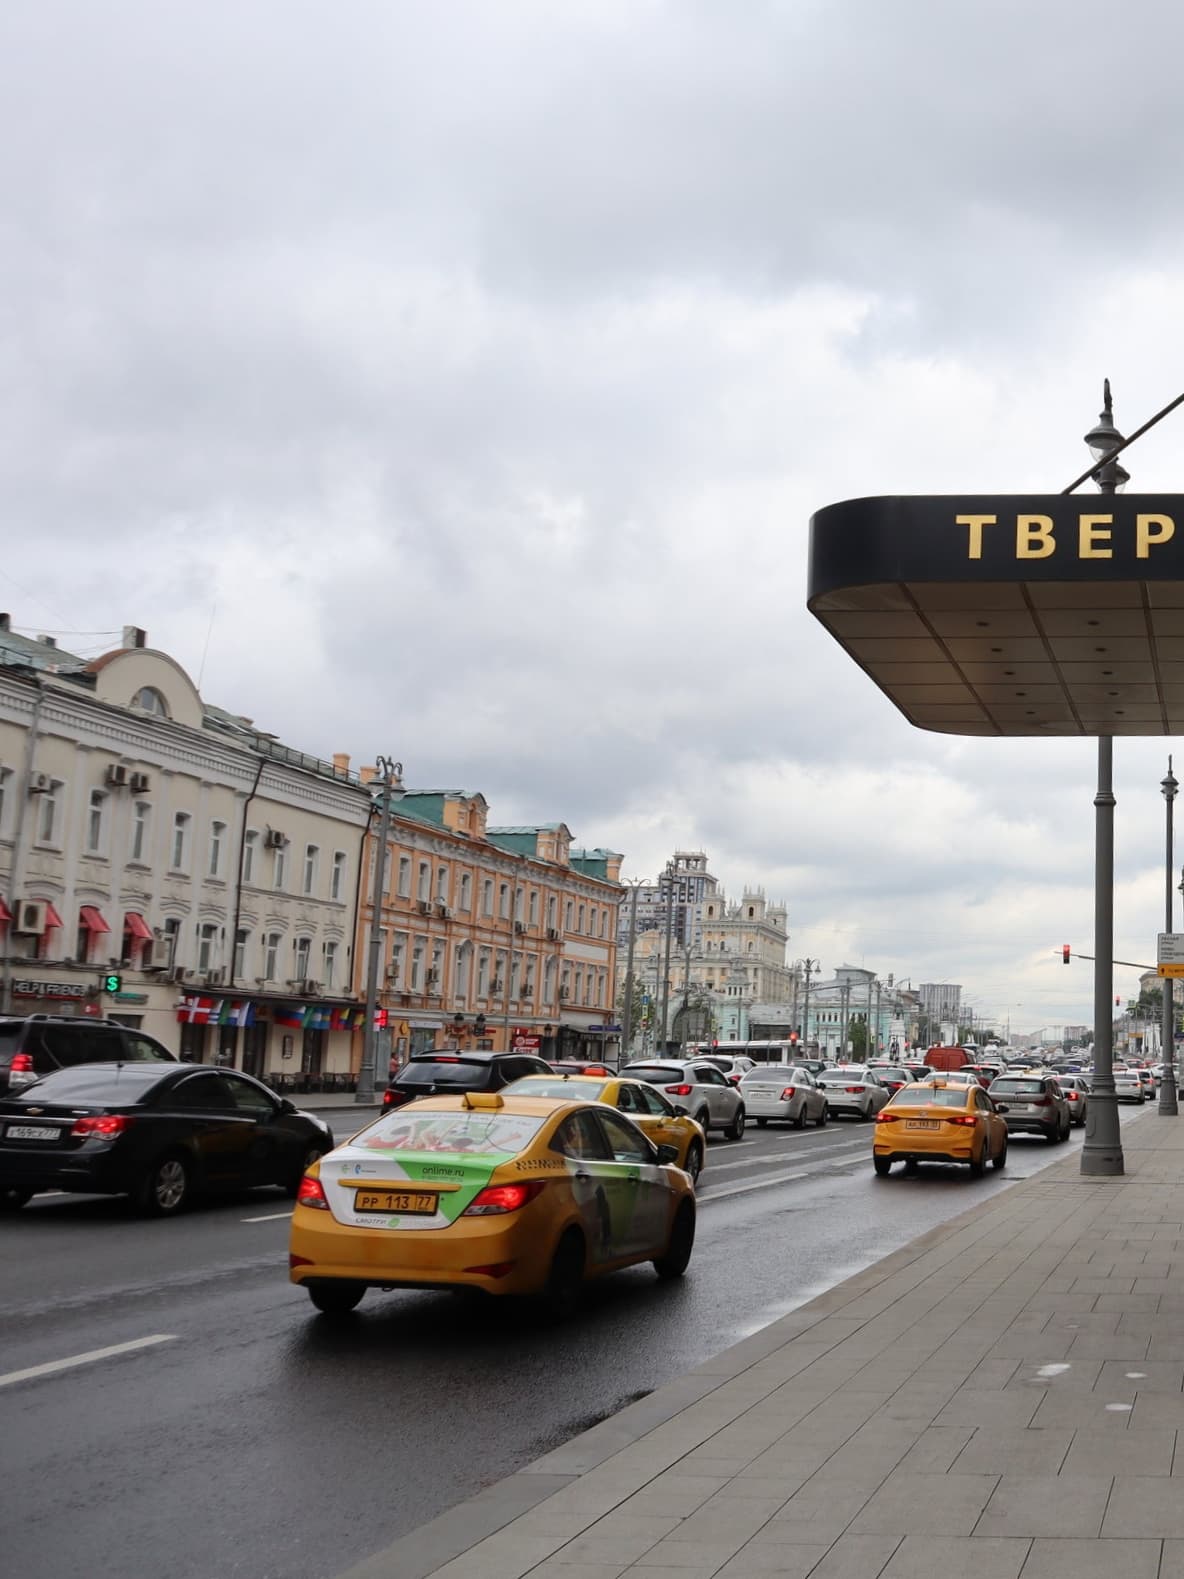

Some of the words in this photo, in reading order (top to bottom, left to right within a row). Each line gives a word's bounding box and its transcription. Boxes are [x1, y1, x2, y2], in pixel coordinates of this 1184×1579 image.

[14, 981, 39, 993] HELP
[422, 1166, 465, 1177] onlime.ru
[385, 1195, 410, 1209] 113
[417, 1196, 431, 1207] 77
